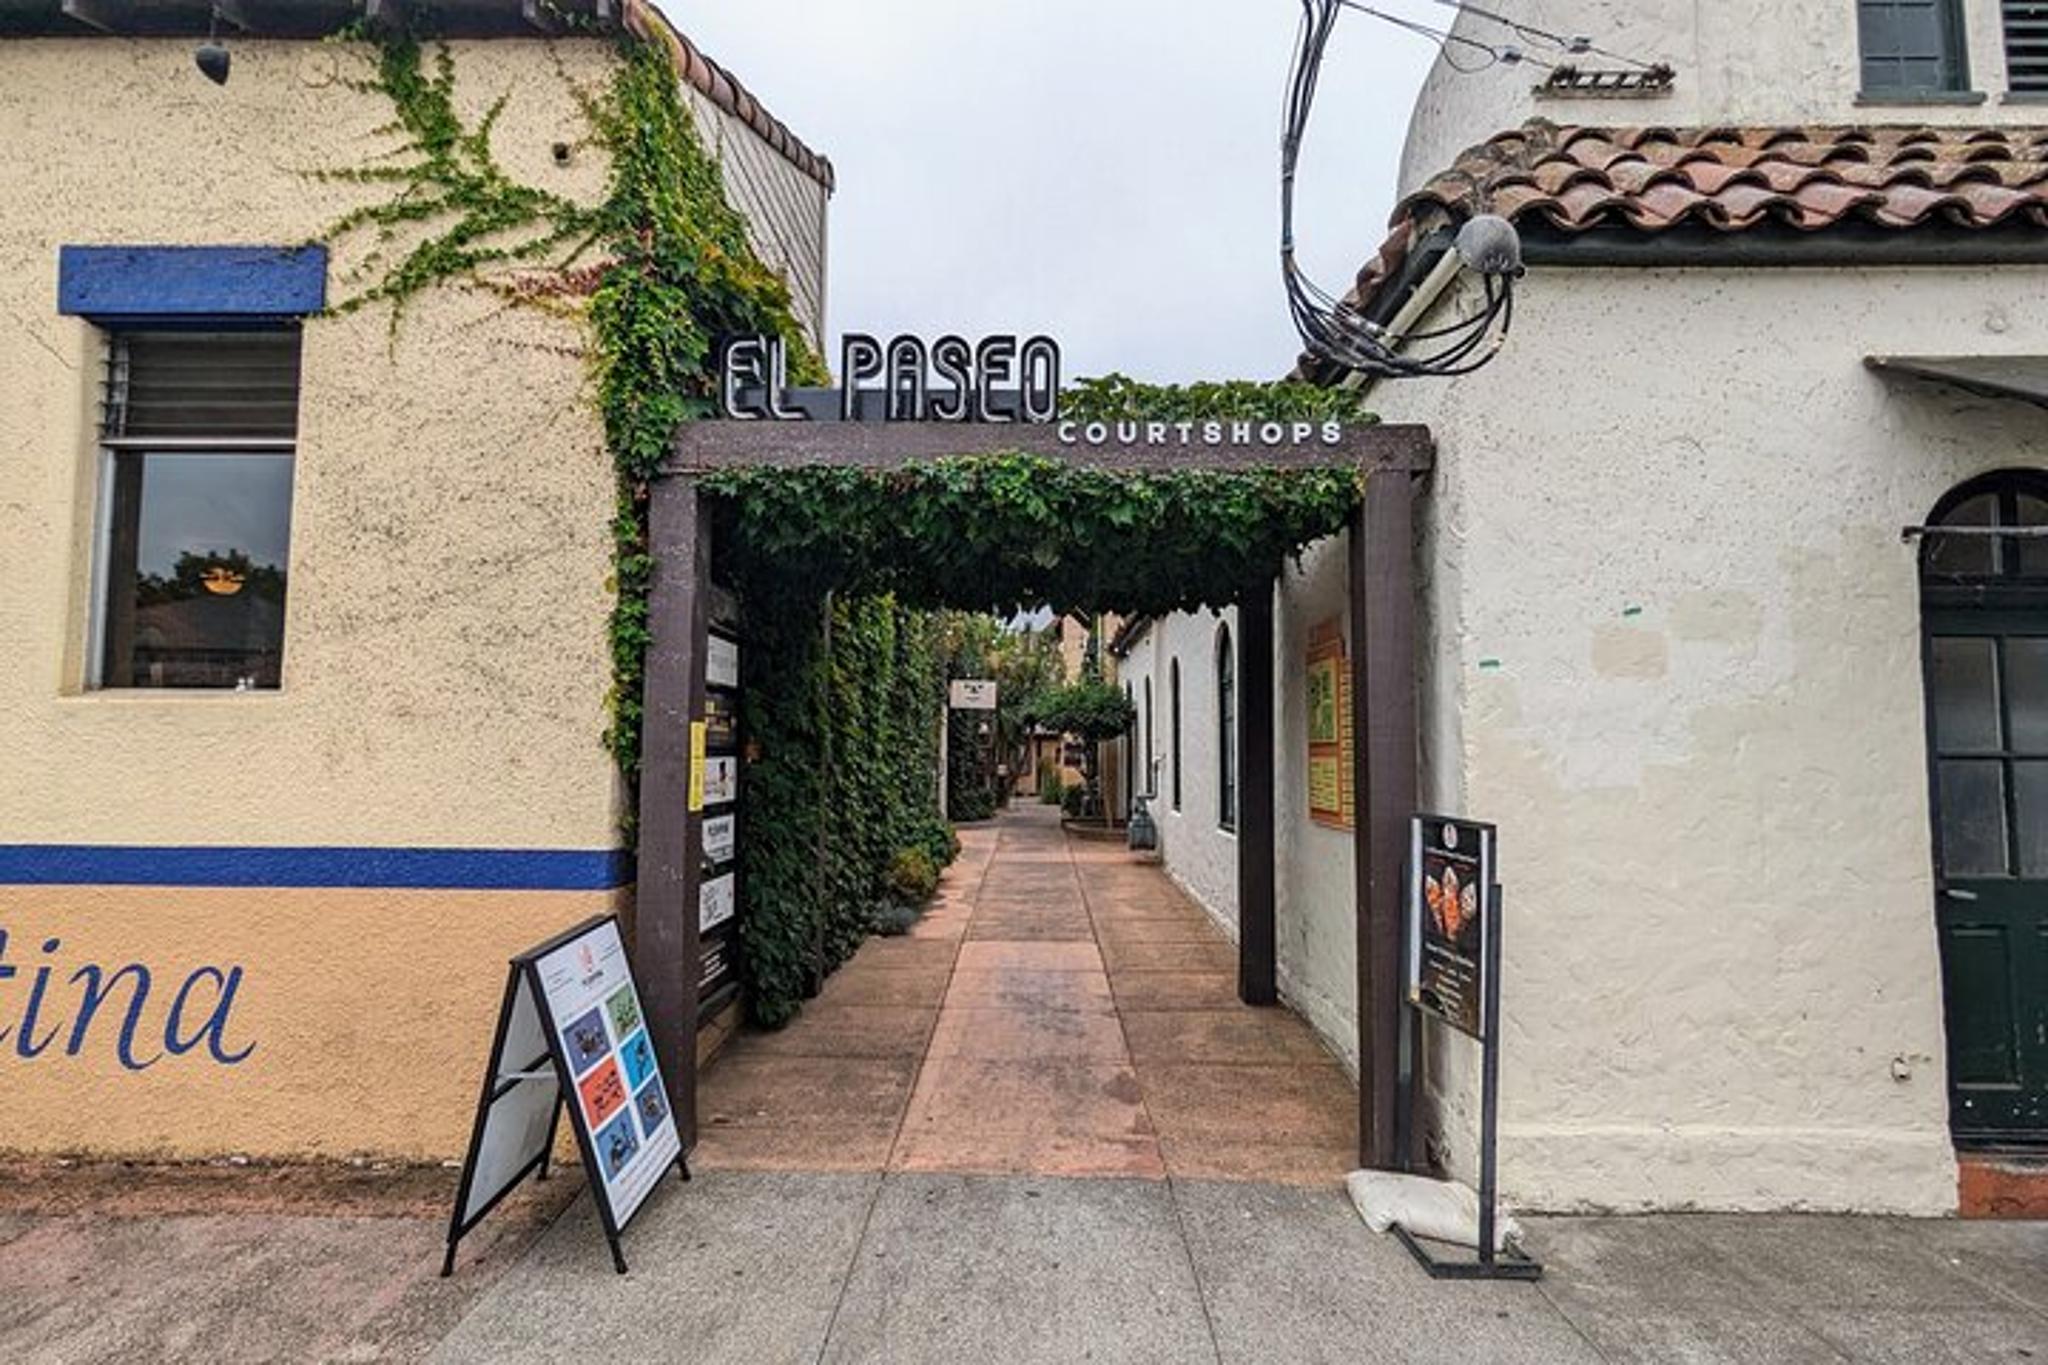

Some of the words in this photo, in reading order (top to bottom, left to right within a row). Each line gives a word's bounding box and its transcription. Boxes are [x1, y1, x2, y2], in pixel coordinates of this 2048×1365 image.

[722, 333, 811, 420] EL
[841, 334, 1061, 422] PASEO
[1057, 421, 1342, 444] COURTSHOPS
